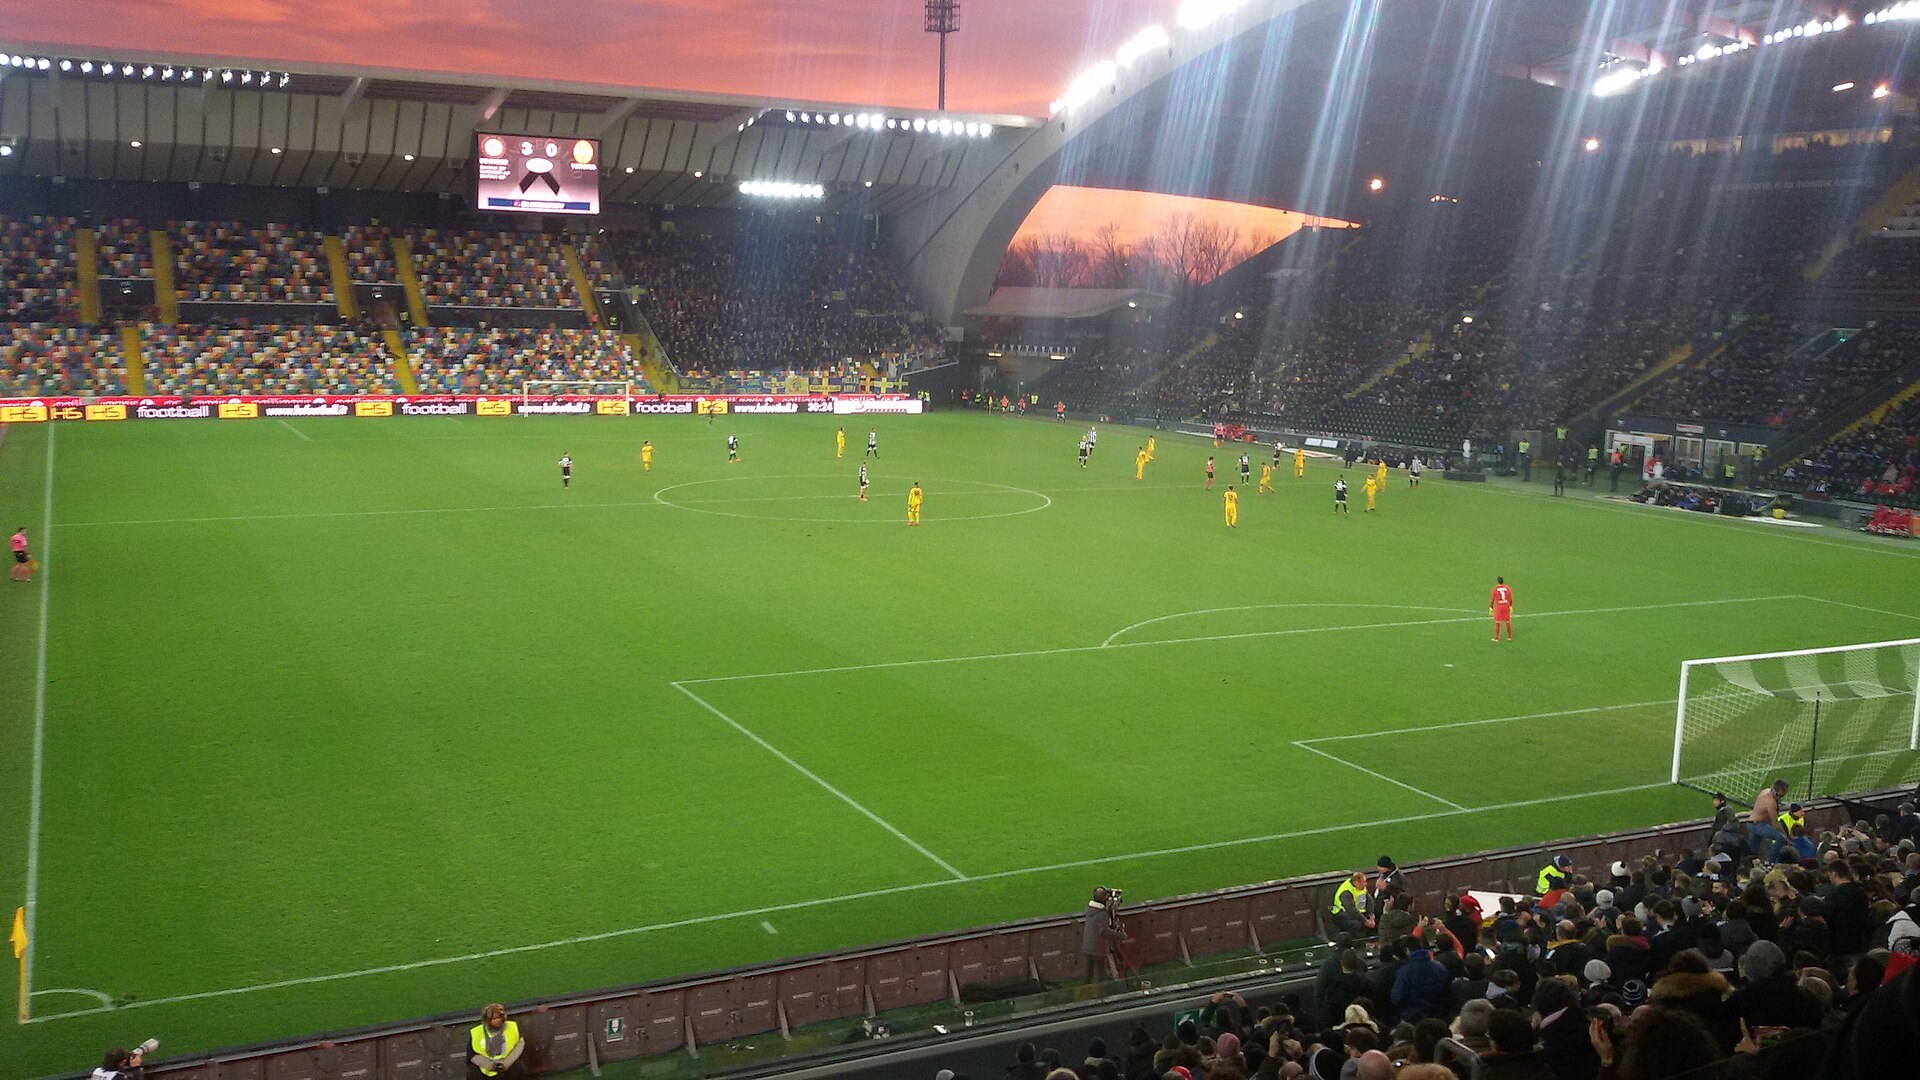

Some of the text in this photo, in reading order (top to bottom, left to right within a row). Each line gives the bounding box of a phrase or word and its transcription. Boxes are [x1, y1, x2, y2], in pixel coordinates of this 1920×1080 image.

[521, 141, 558, 158] 3 0
[136, 405, 209, 418] football
[401, 403, 467, 415] football
[635, 402, 692, 413] football
[808, 402, 833, 412] 30:24
[1500, 590, 1506, 601] 1
